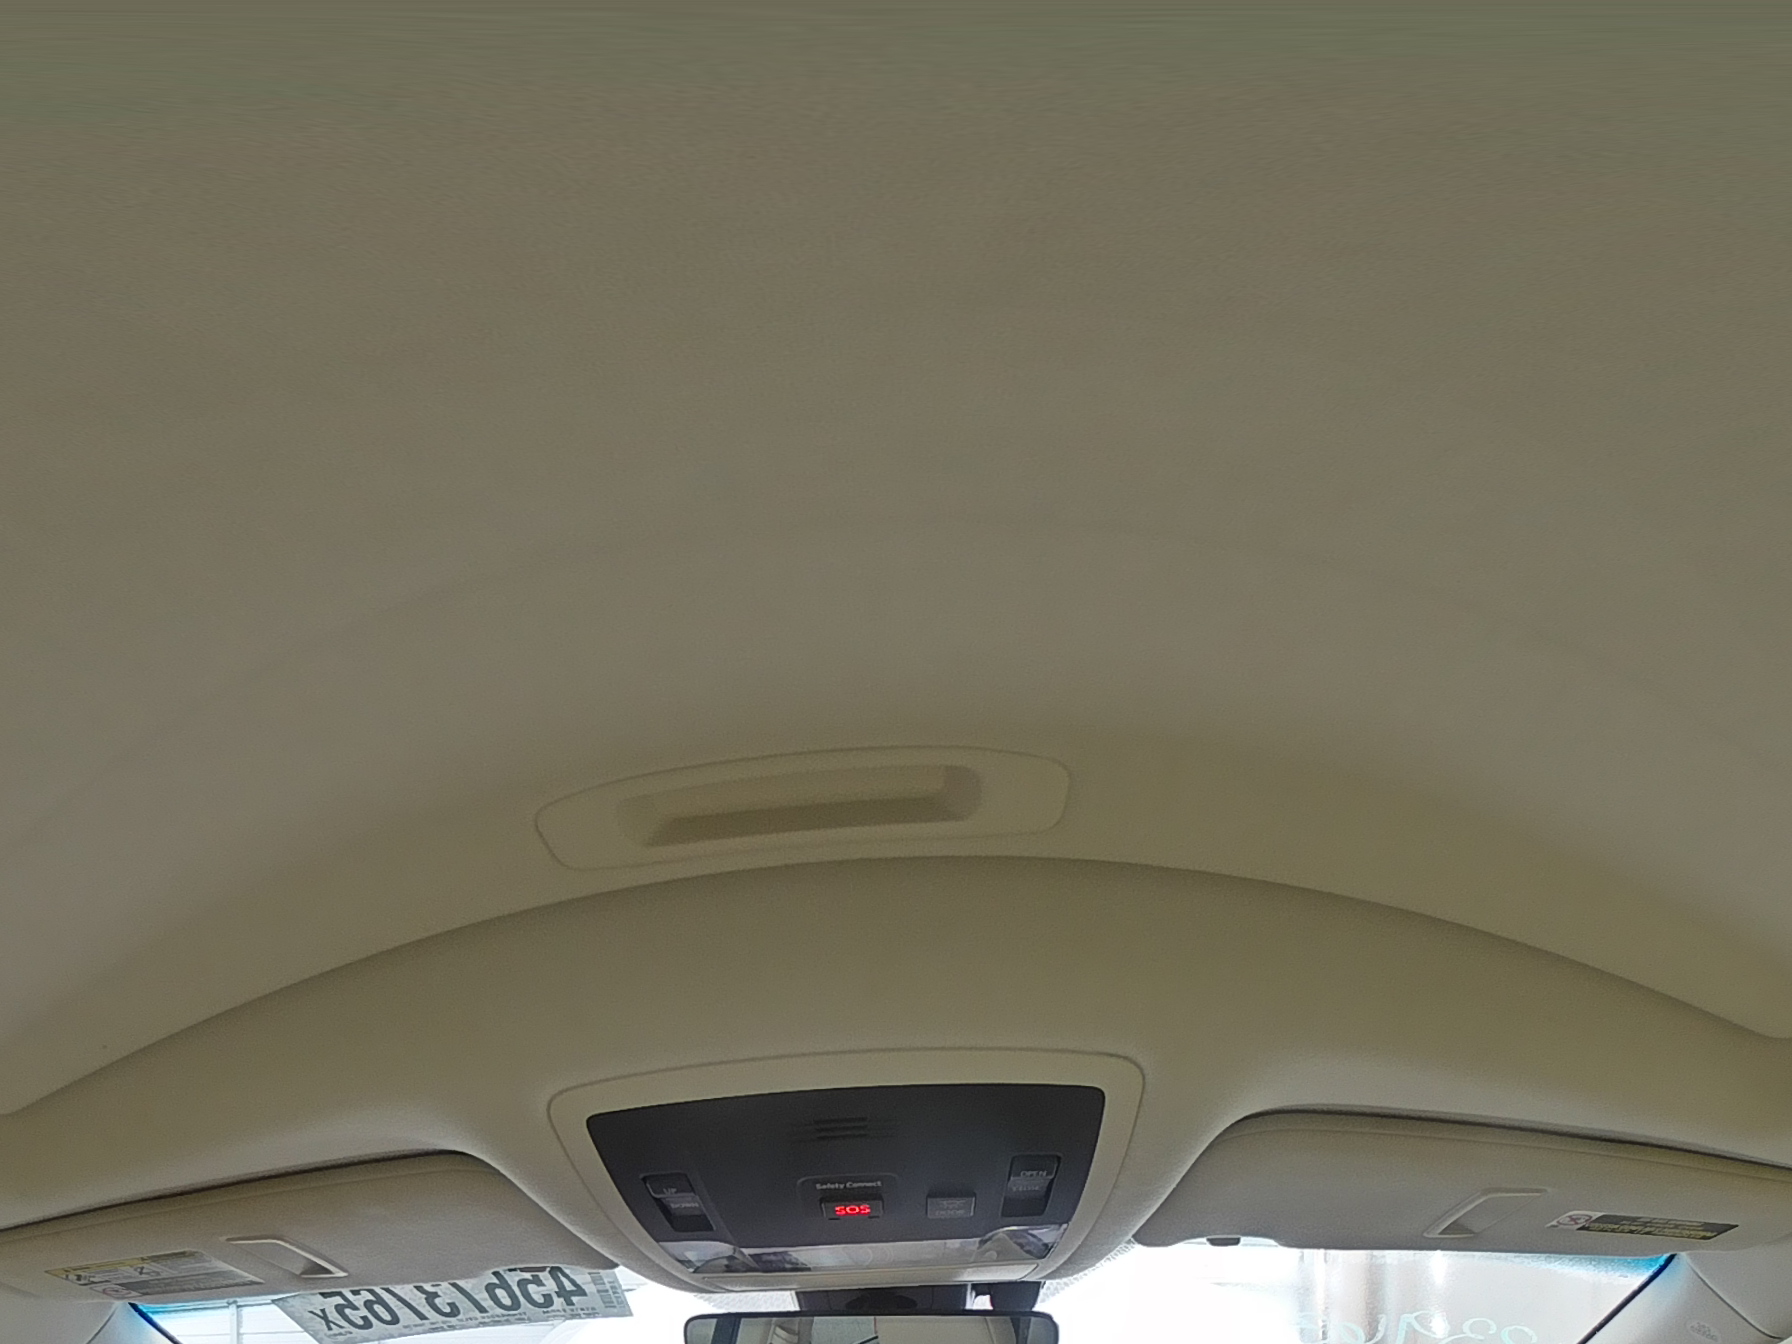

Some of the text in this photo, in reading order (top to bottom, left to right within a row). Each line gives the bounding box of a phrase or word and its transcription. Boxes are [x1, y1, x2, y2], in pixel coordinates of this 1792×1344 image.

[815, 1180, 882, 1190] Safety Connect
[834, 1203, 871, 1217] SOS
